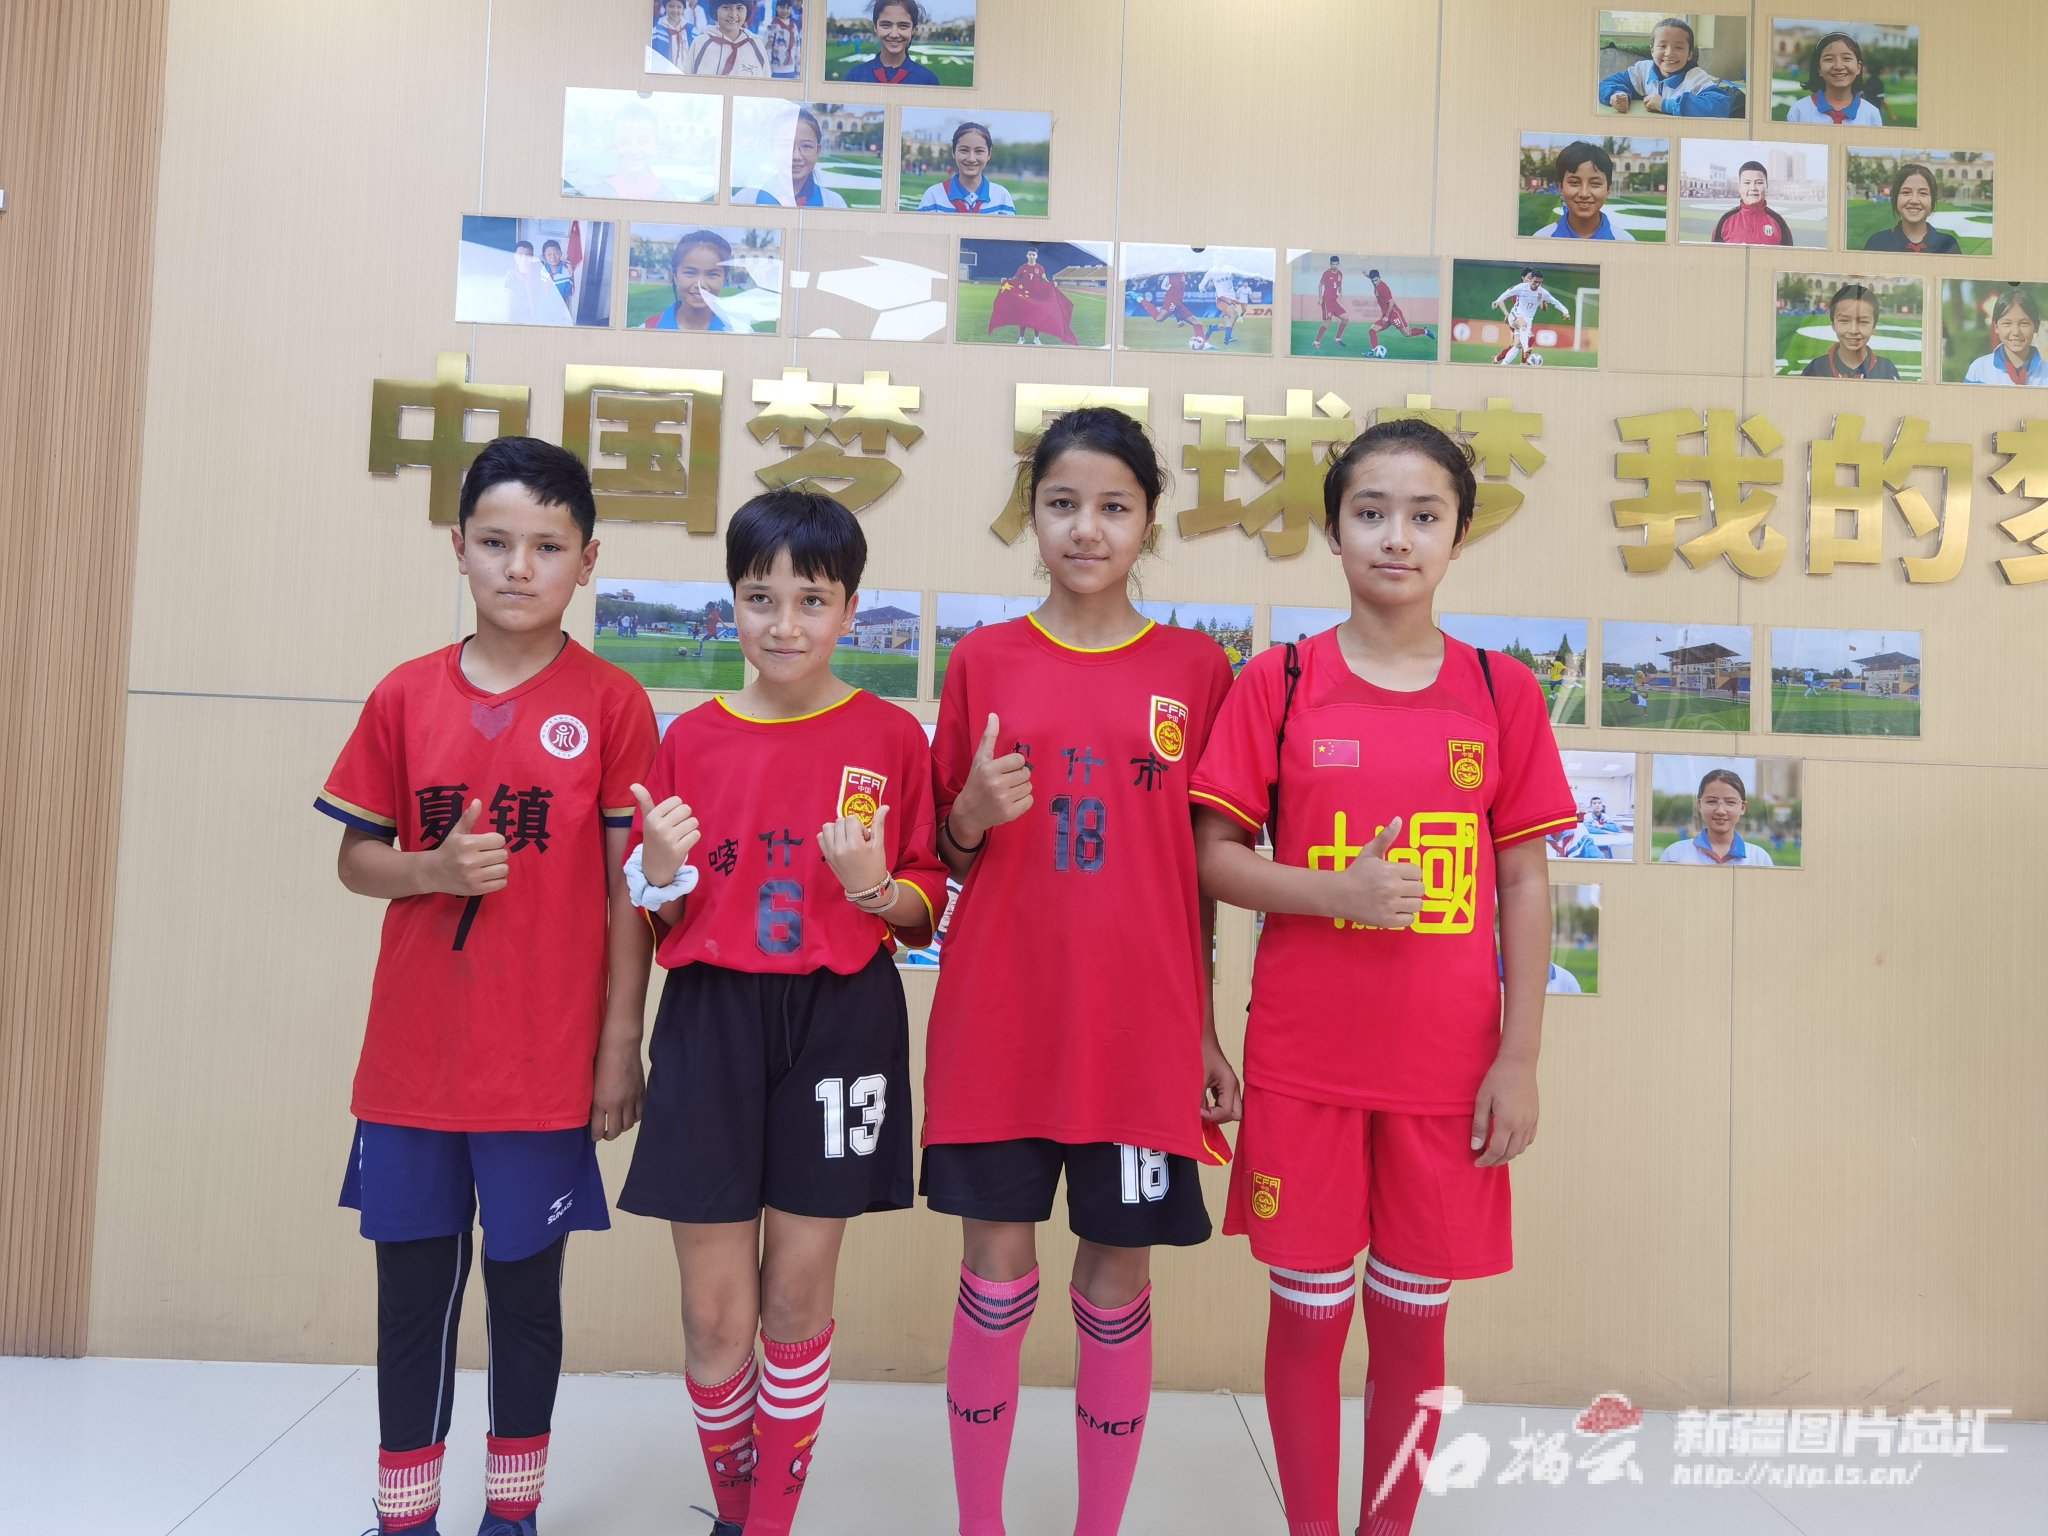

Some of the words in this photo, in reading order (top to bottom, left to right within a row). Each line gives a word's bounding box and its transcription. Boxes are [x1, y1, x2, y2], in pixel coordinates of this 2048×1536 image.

[369, 352, 925, 534] 中国梦
[1157, 701, 1187, 721] CFA
[1452, 743, 1482, 754] CFA
[848, 772, 881, 791] CFA
[415, 782, 554, 855] 夏镇
[1049, 794, 1107, 875] 18
[755, 877, 805, 957] 6
[815, 1073, 888, 1159] 13
[1113, 1142, 1171, 1204] 18
[1255, 1175, 1278, 1189] CFA
[1077, 1403, 1144, 1436] RMCF
